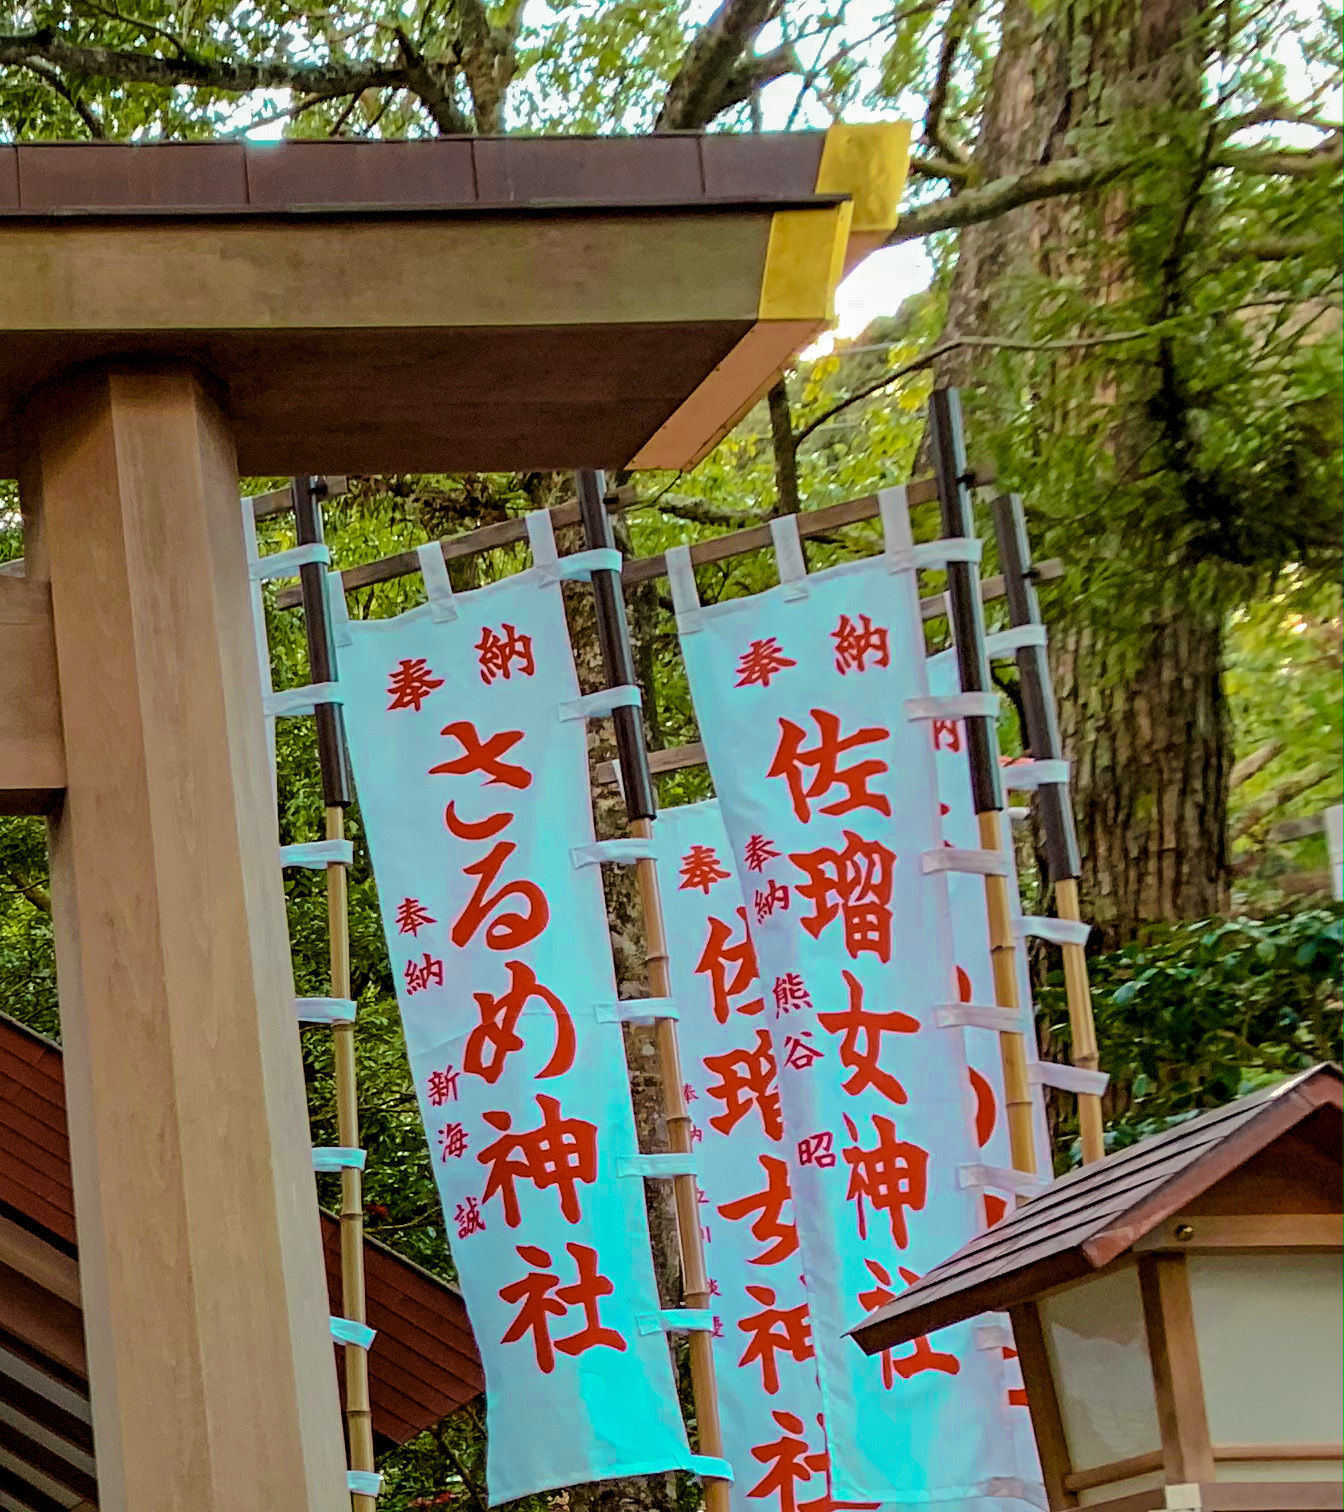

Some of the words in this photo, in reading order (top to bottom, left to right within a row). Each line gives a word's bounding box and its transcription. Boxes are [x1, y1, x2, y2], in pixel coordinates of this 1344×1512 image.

[386, 623, 536, 712] 奉納
[734, 613, 891, 688] 奉納
[678, 845, 732, 896] 奉
[744, 834, 790, 924] 奉納
[395, 897, 445, 996] 奉納
[429, 720, 627, 1374] さるめ神社
